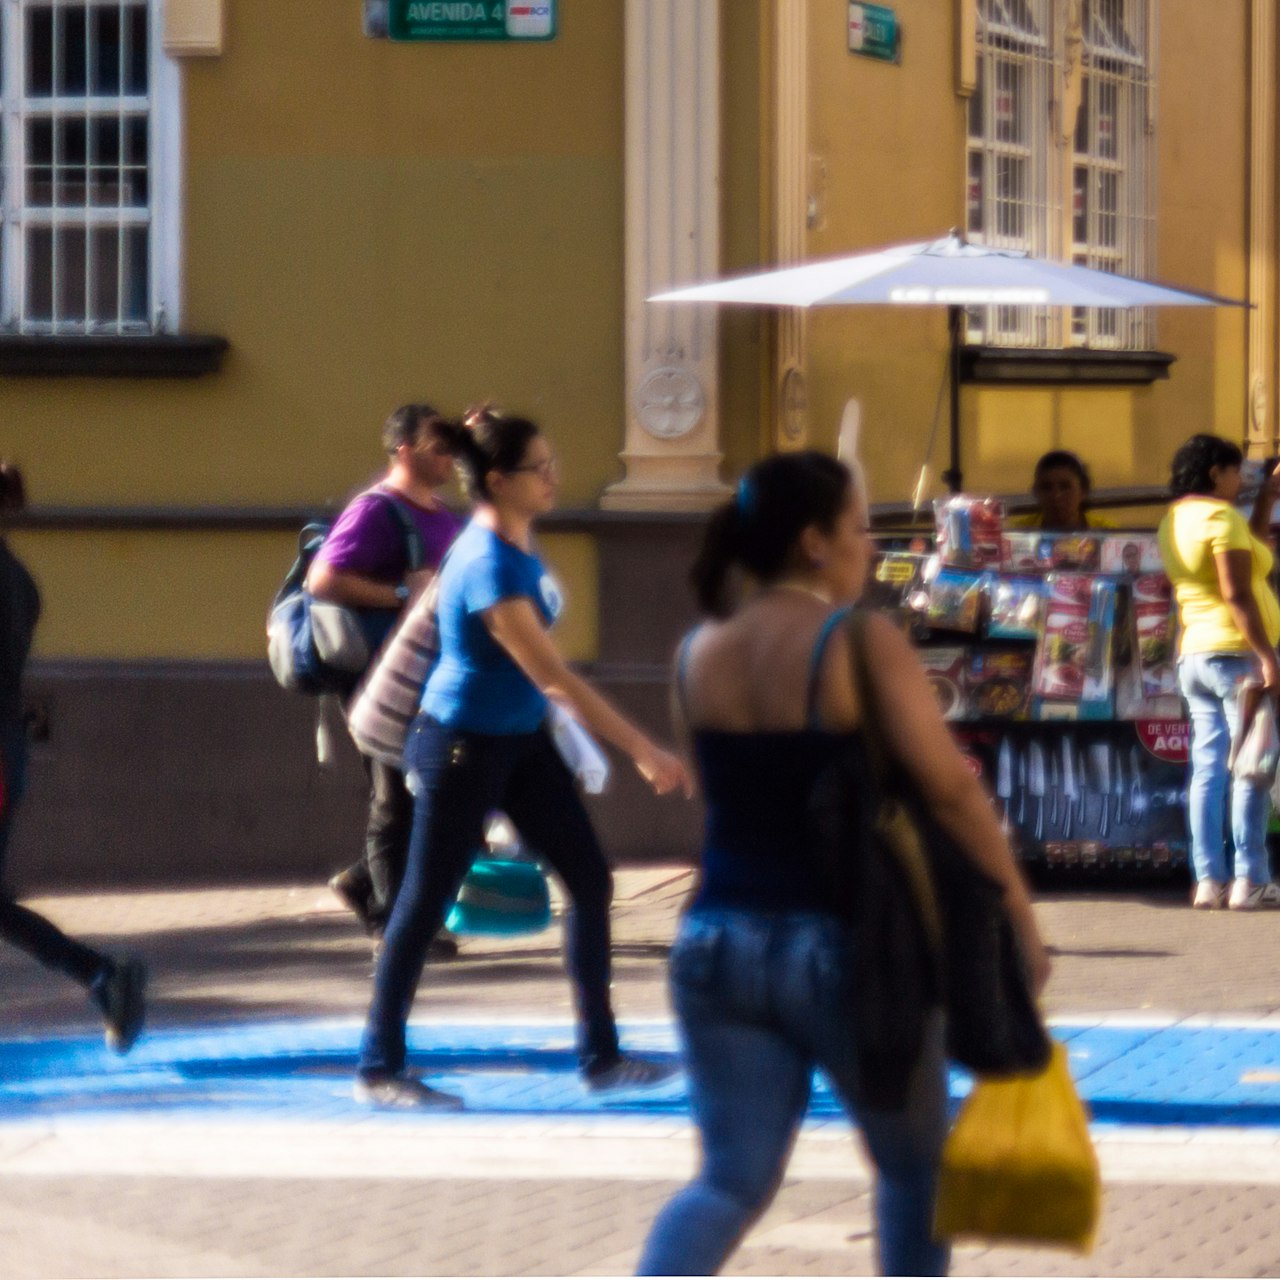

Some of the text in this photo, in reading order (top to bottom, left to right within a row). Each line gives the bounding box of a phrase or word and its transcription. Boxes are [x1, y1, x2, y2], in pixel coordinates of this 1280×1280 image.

[406, 2, 503, 21] AVENIDA 4
[1148, 724, 1161, 735] DE
